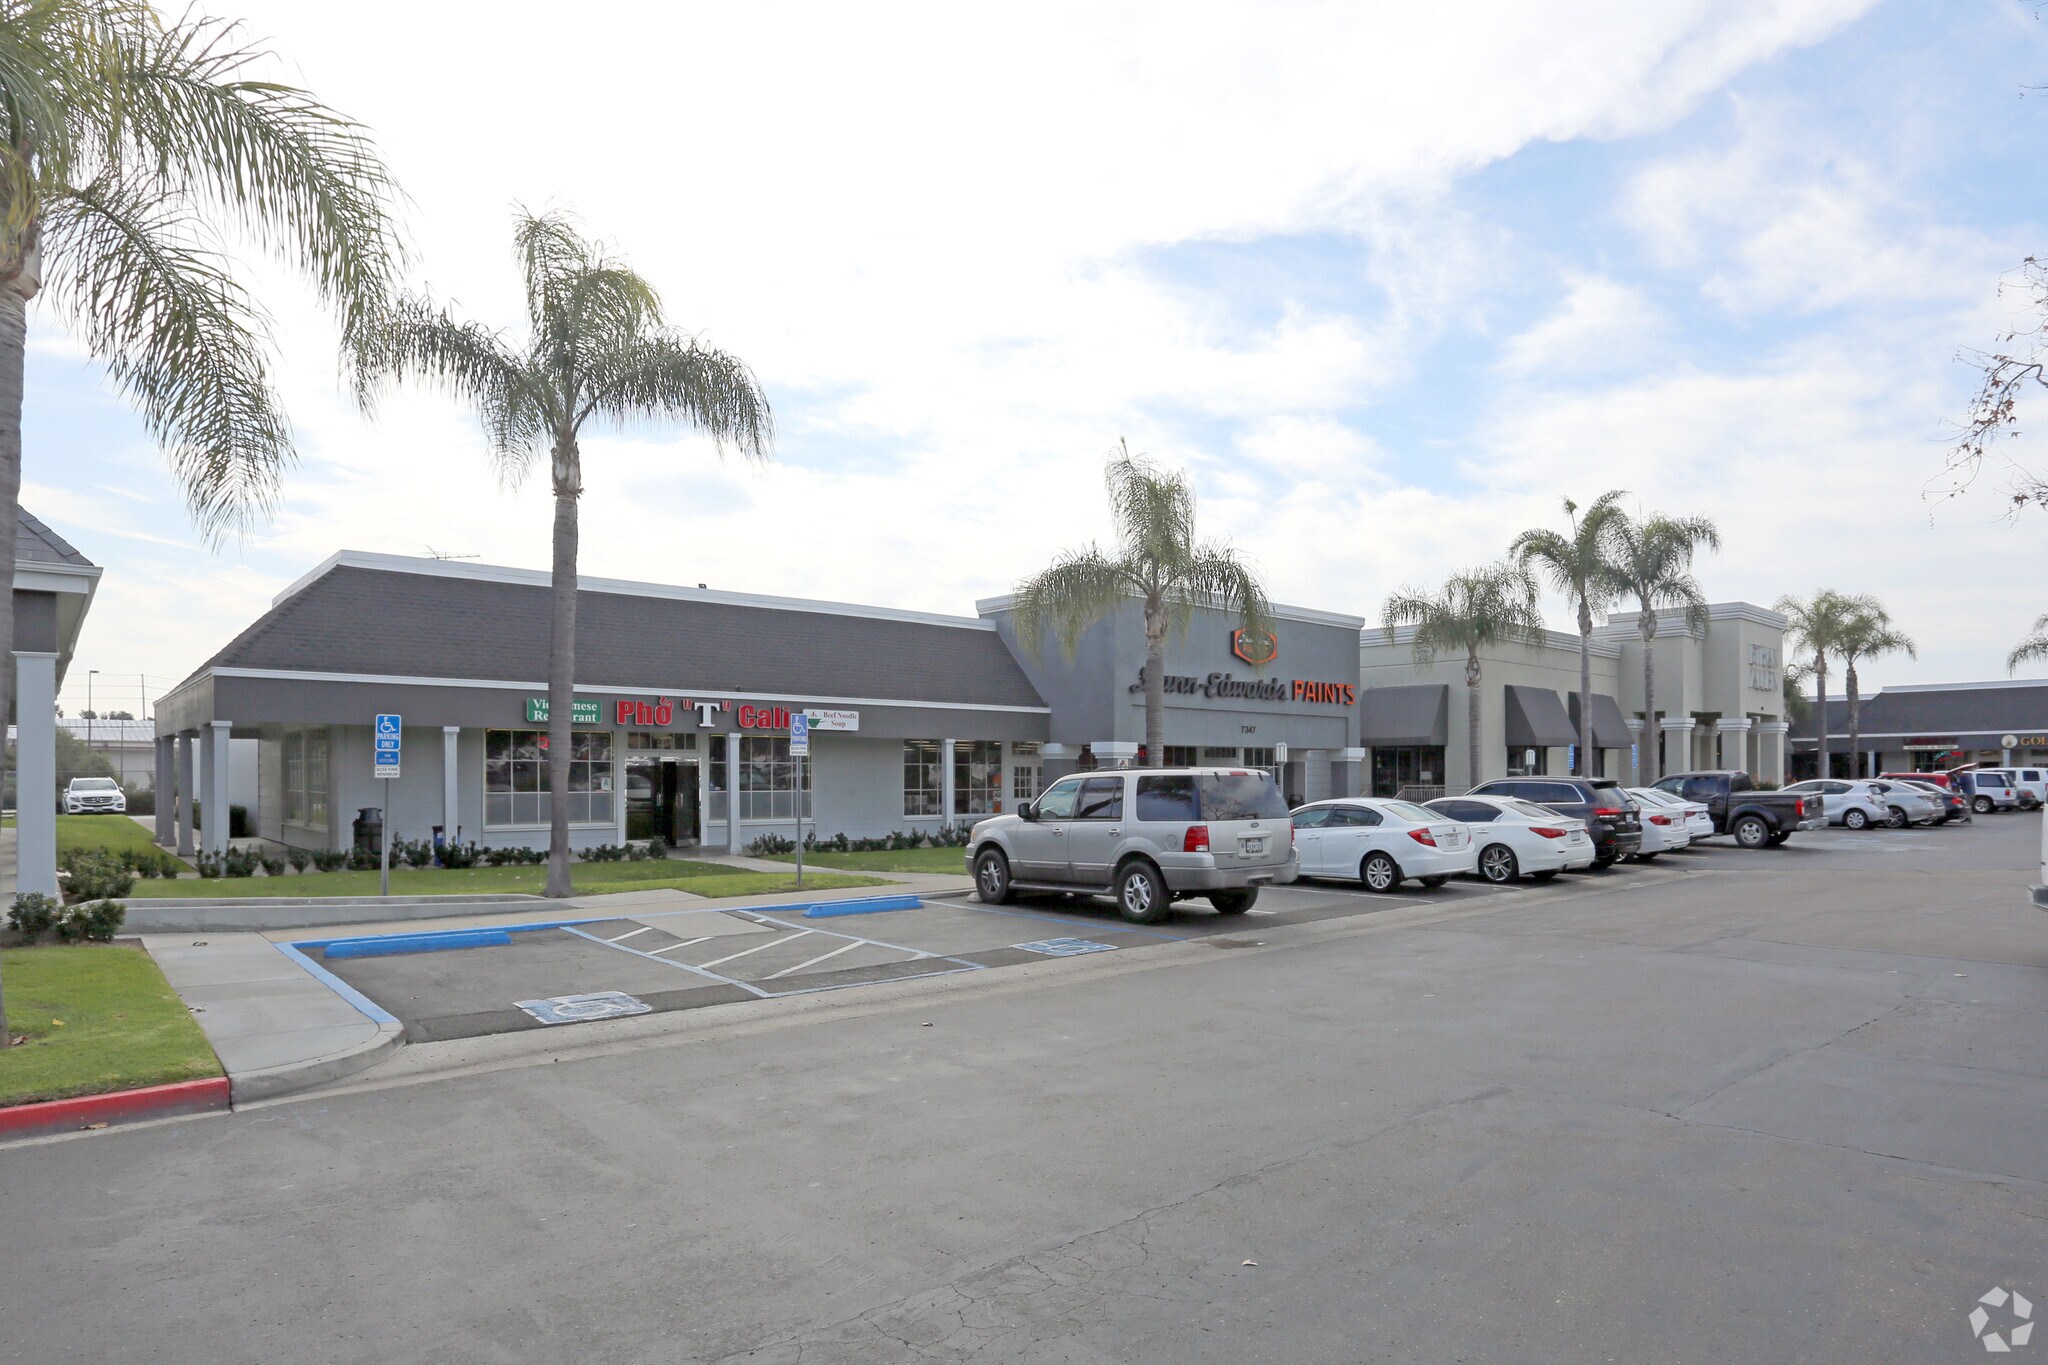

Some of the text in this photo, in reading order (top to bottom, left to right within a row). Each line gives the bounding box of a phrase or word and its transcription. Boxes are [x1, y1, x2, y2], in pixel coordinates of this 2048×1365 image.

[1292, 679, 1356, 705] PAINTS
[533, 699, 597, 711] Vimese
[534, 711, 597, 722] Rerant
[738, 705, 791, 729] Cali
[823, 711, 857, 720] Beef Noodle
[831, 720, 846, 728] Soup
[1240, 725, 1256, 734] 7347
[377, 732, 399, 740] PARKING
[602, 779, 609, 787] A
